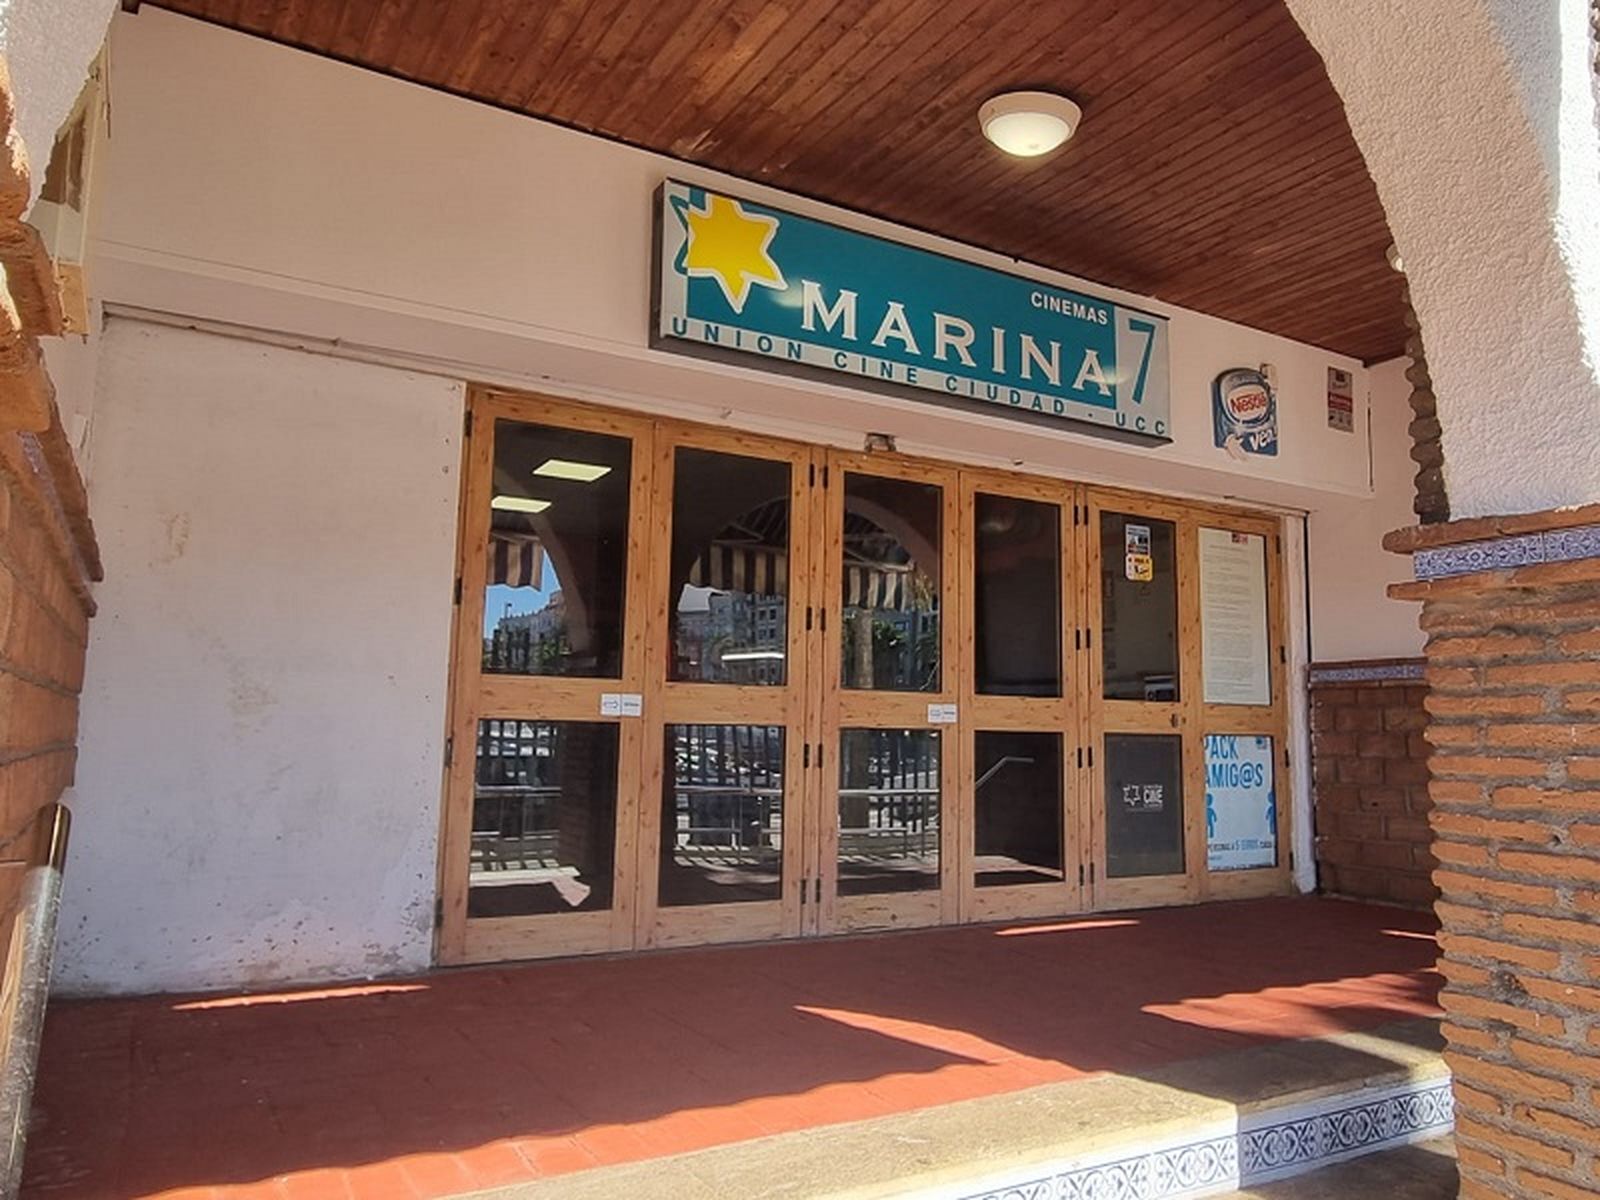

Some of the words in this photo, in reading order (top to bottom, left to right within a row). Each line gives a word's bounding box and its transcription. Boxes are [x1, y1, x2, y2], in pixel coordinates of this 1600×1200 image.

[801, 279, 1112, 397] MARINA
[1129, 317, 1156, 404] 7
[1031, 291, 1108, 326] CINEMAS
[673, 317, 801, 360] UNION
[834, 351, 918, 384] CINE
[946, 376, 1065, 414] CIUDAD
[1116, 412, 1165, 435] UCC
